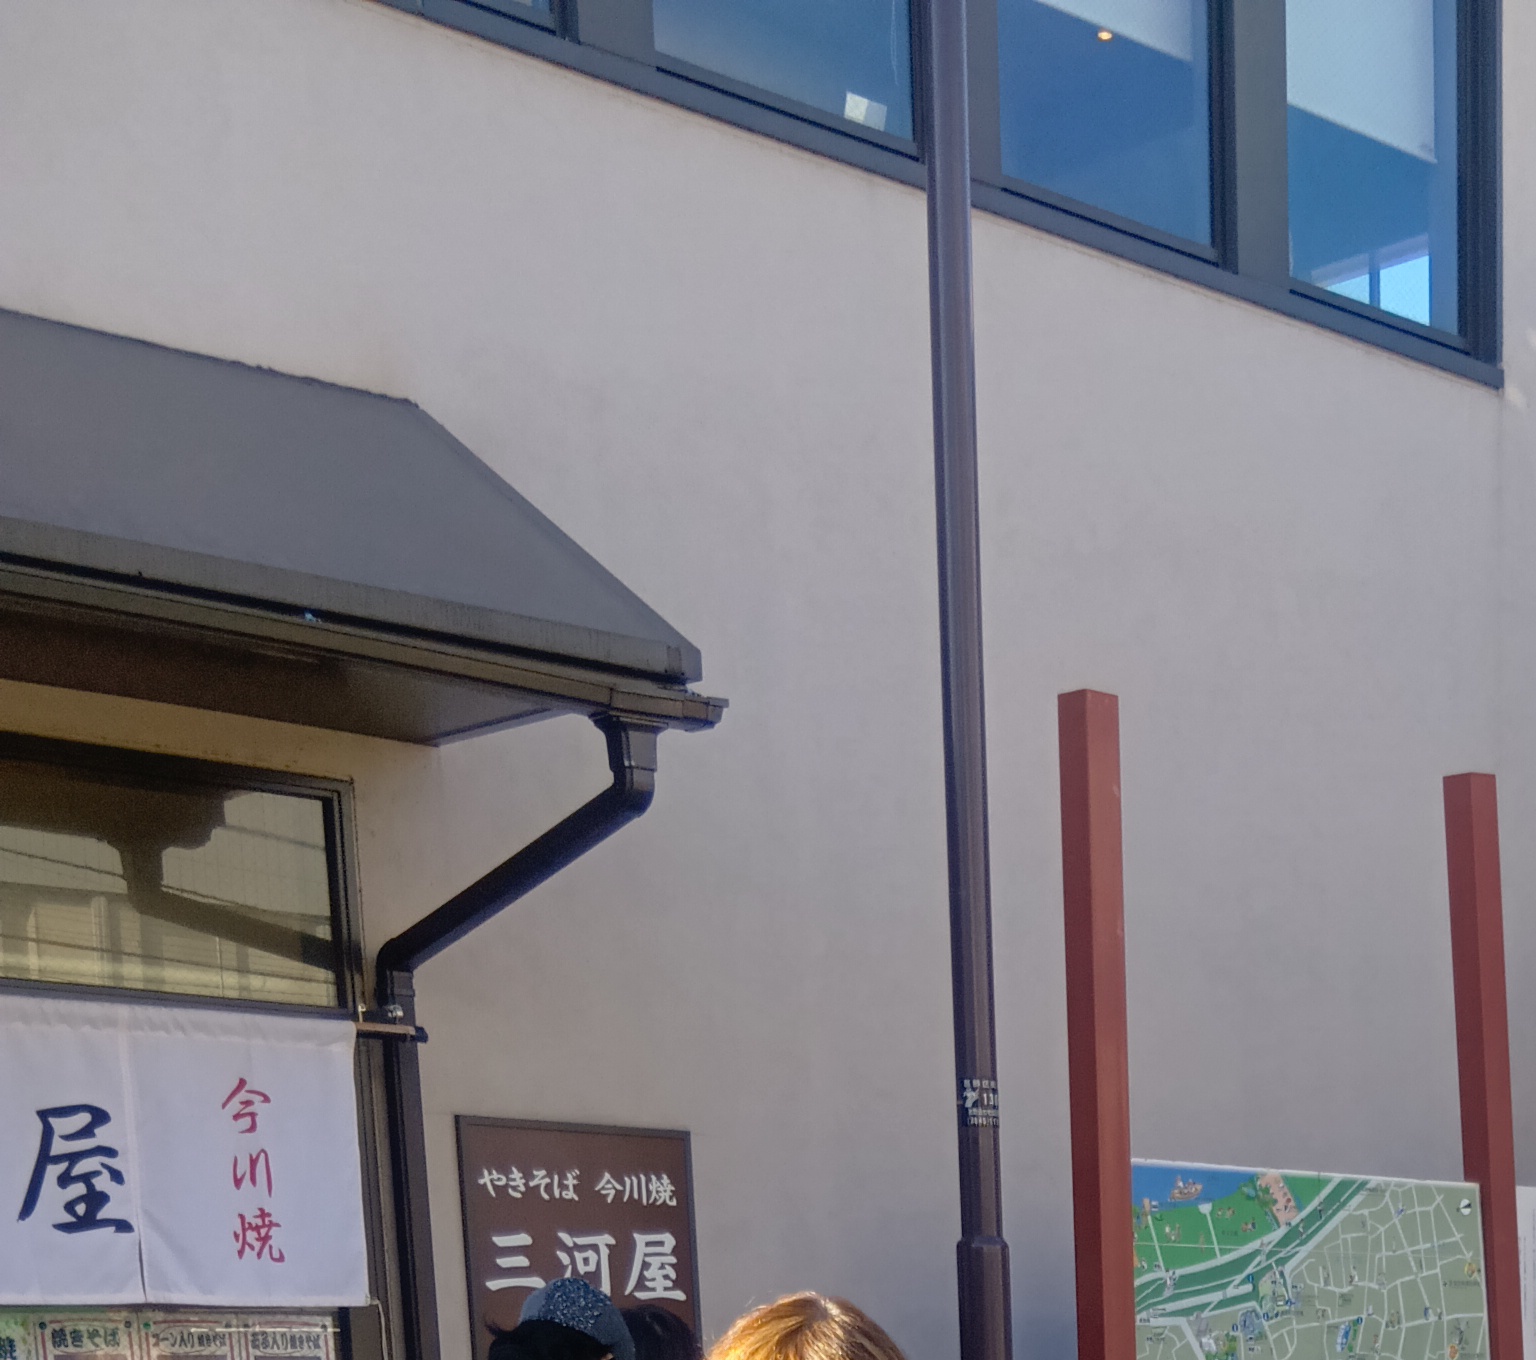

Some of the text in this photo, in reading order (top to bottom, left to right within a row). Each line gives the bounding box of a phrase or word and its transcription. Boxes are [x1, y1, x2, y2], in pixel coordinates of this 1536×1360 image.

[17, 1104, 136, 1235] 屋
[222, 1077, 286, 1264] 今川焼
[478, 1167, 677, 1207] やきそば 今川焼
[485, 1232, 687, 1303] 三河屋
[51, 1327, 120, 1348] 焼きそば
